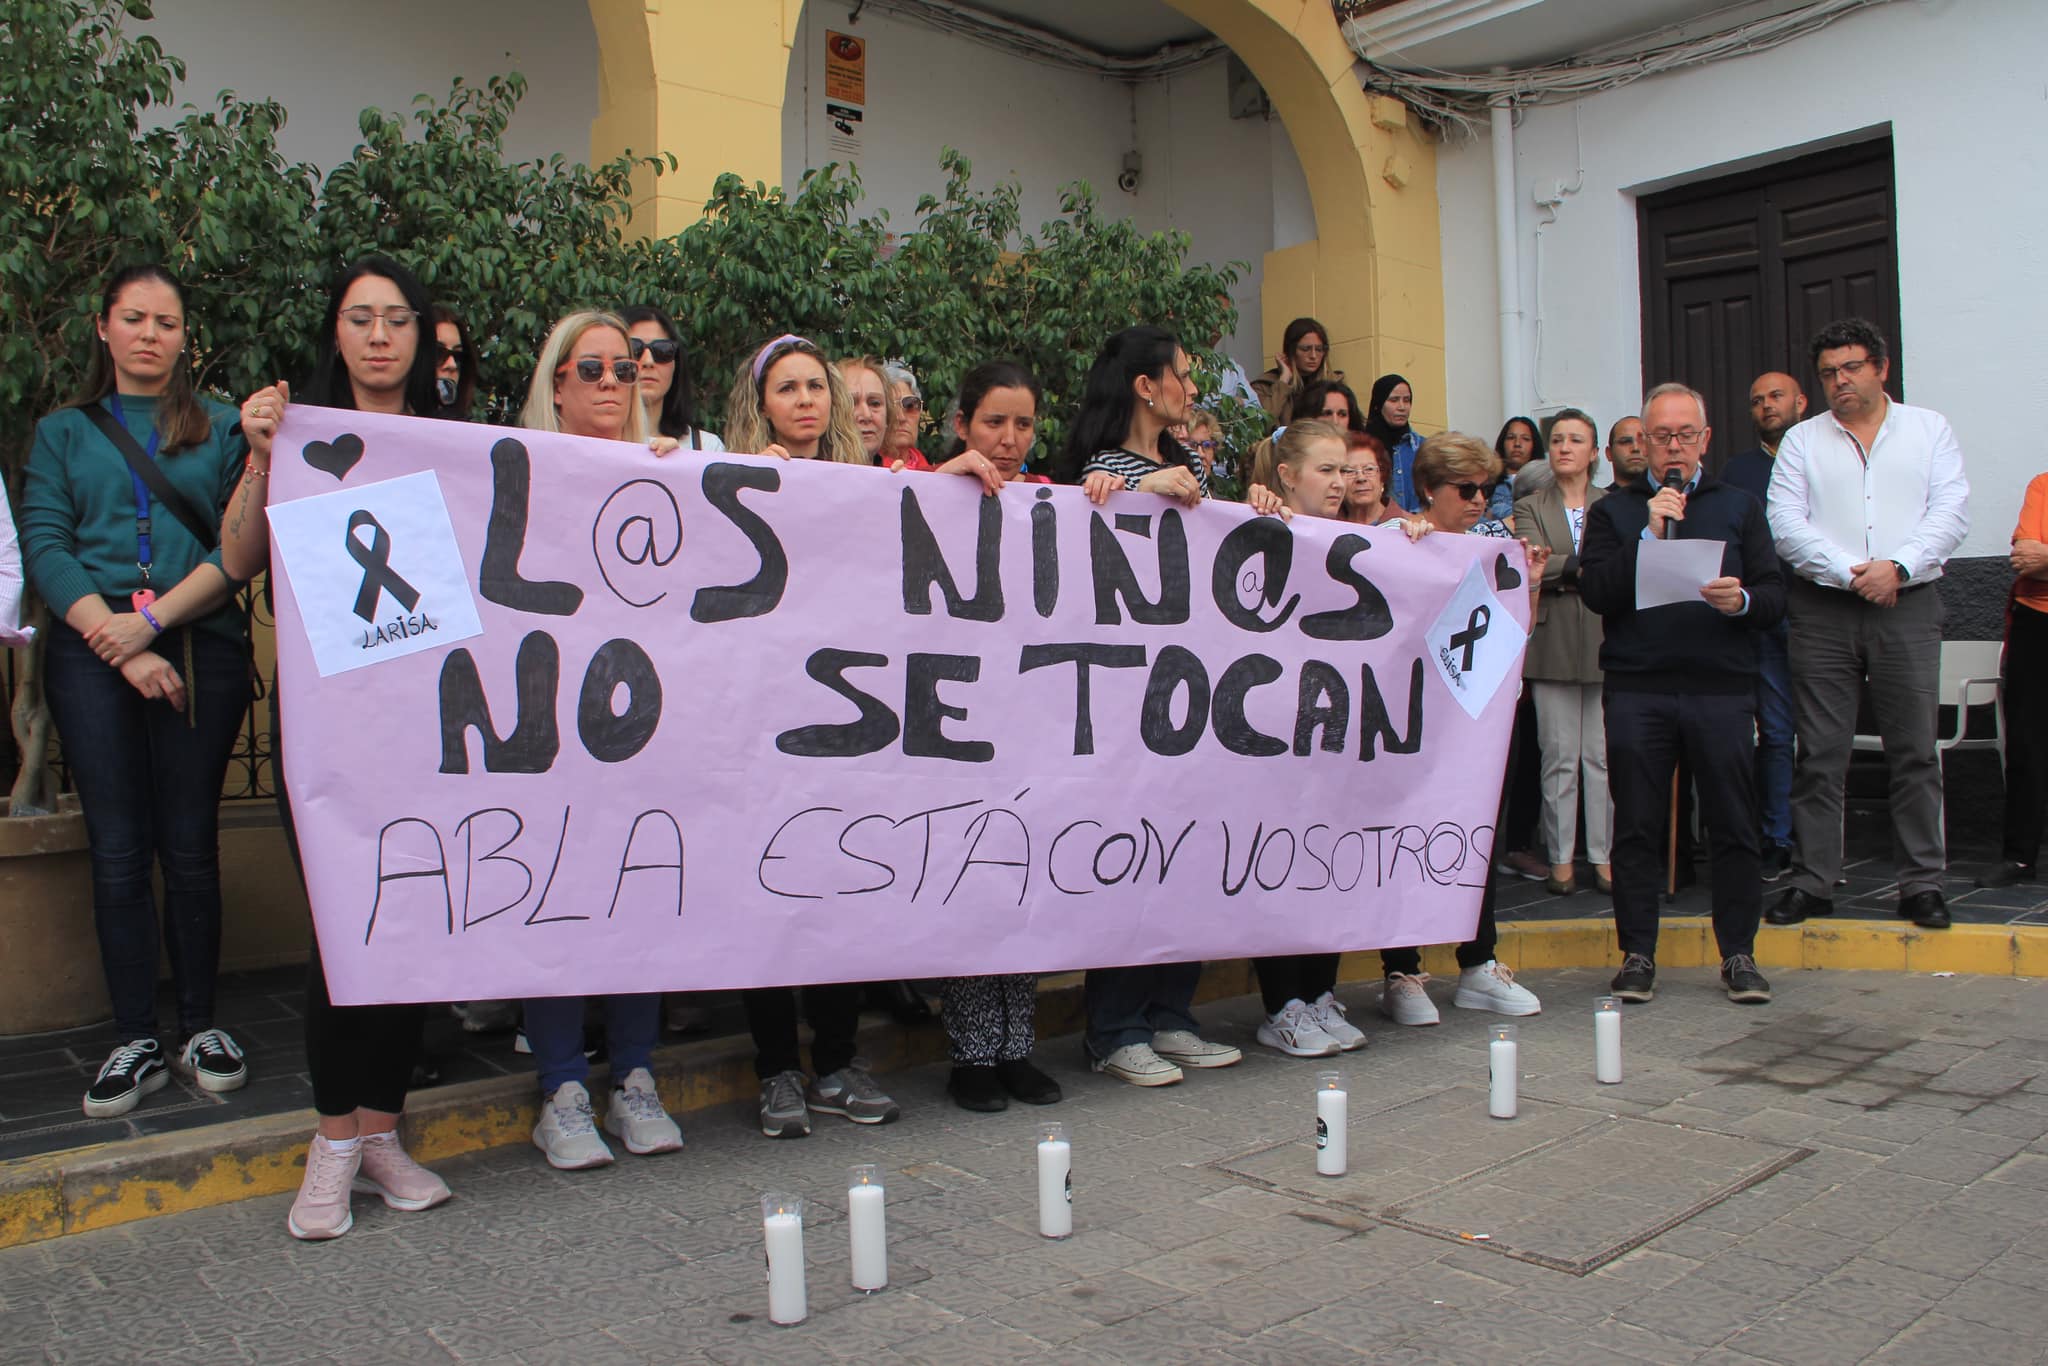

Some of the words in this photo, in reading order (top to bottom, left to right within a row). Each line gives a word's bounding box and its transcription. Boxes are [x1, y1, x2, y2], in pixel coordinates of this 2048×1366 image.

[480, 437, 788, 623] L@S
[439, 630, 662, 774] NO
[776, 648, 994, 763] SE
[1019, 643, 1424, 762] TOCAN
[365, 805, 683, 945] ABLA
[759, 788, 1031, 906] ESTÁ
[1049, 818, 1196, 894] CON
